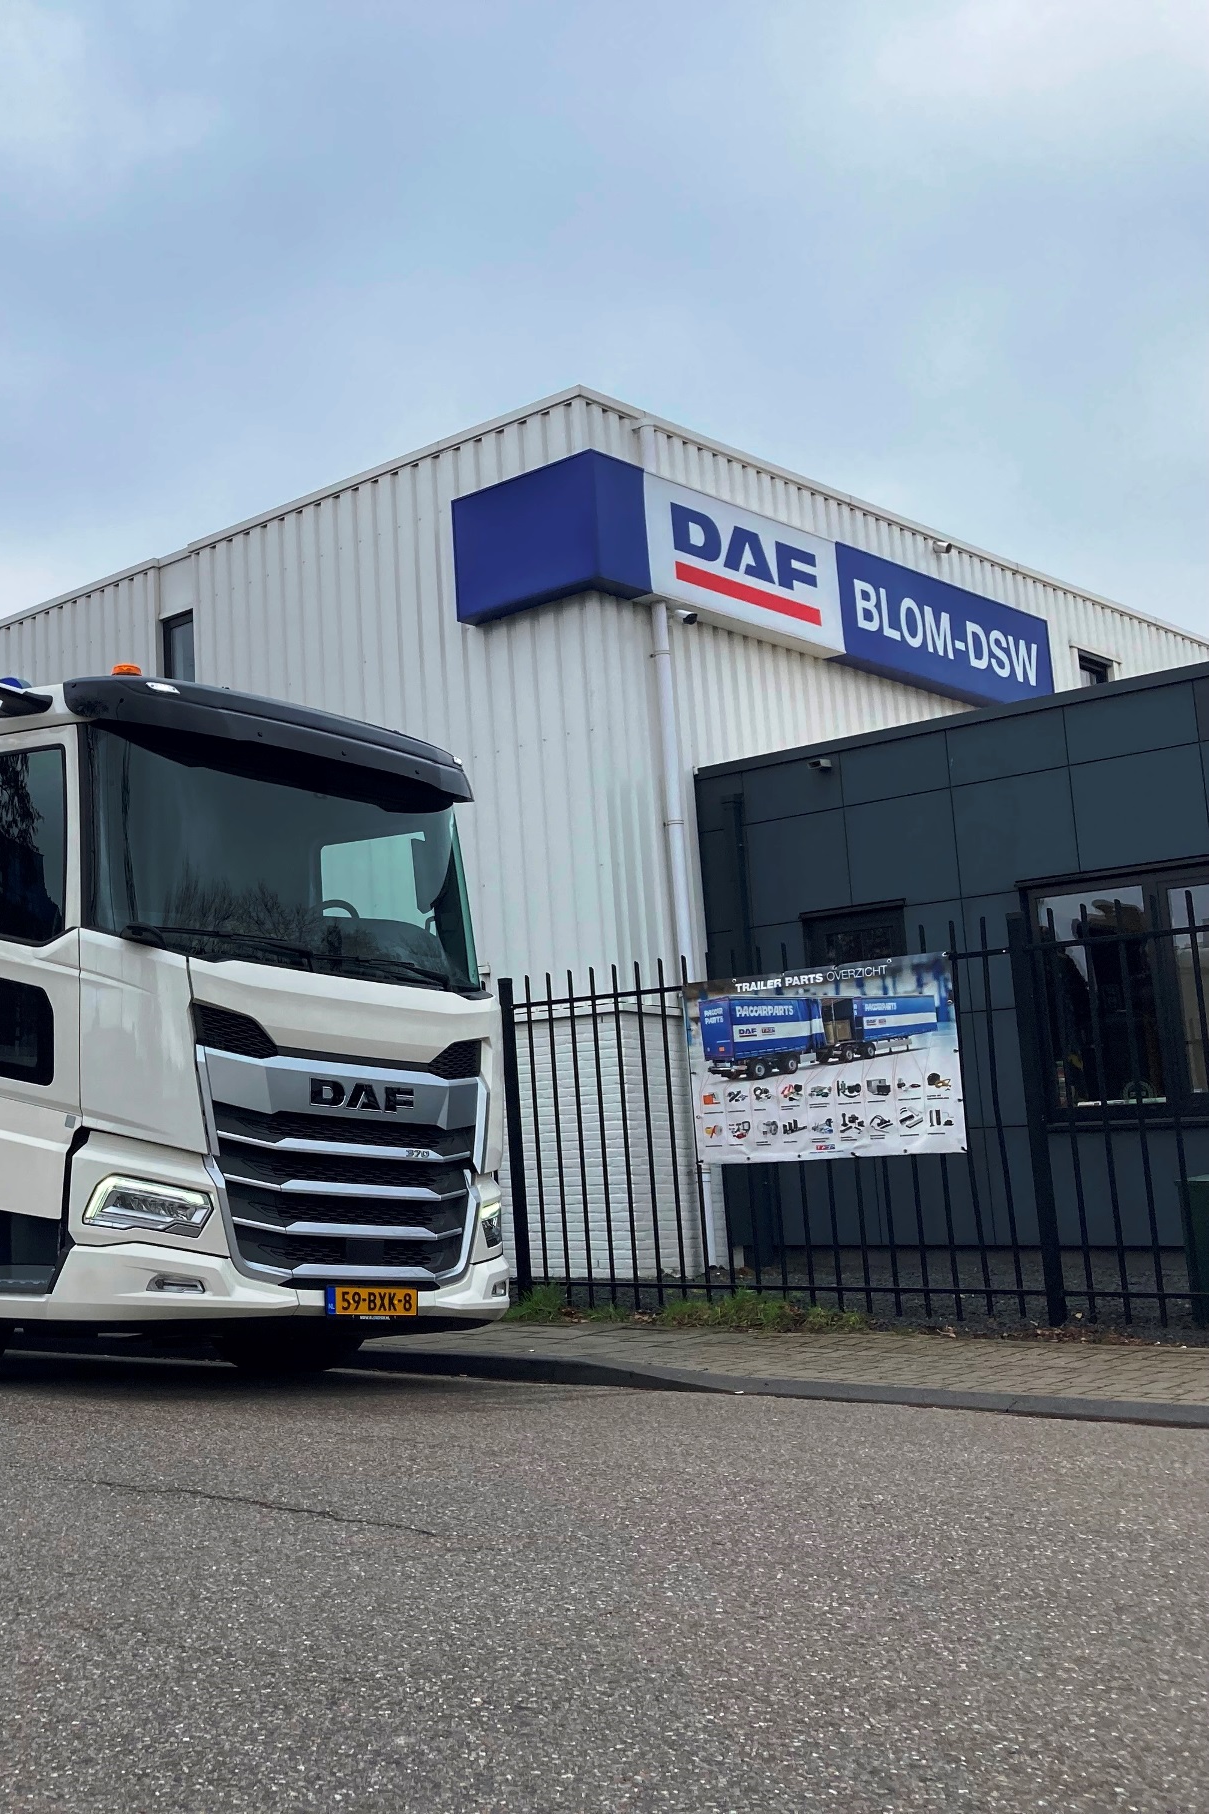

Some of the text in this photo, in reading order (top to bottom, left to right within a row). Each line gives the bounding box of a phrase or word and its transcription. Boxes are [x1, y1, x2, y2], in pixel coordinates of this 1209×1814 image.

[670, 502, 818, 591] DAF
[853, 579, 1038, 687] BLOM-DSW
[735, 964, 888, 993] TRAILER PARTS OVERZICHT
[738, 1027, 758, 1035] DAF
[309, 1077, 415, 1114] DAF
[405, 1149, 430, 1159] 370
[341, 1291, 413, 1312] 59-BXK-8
